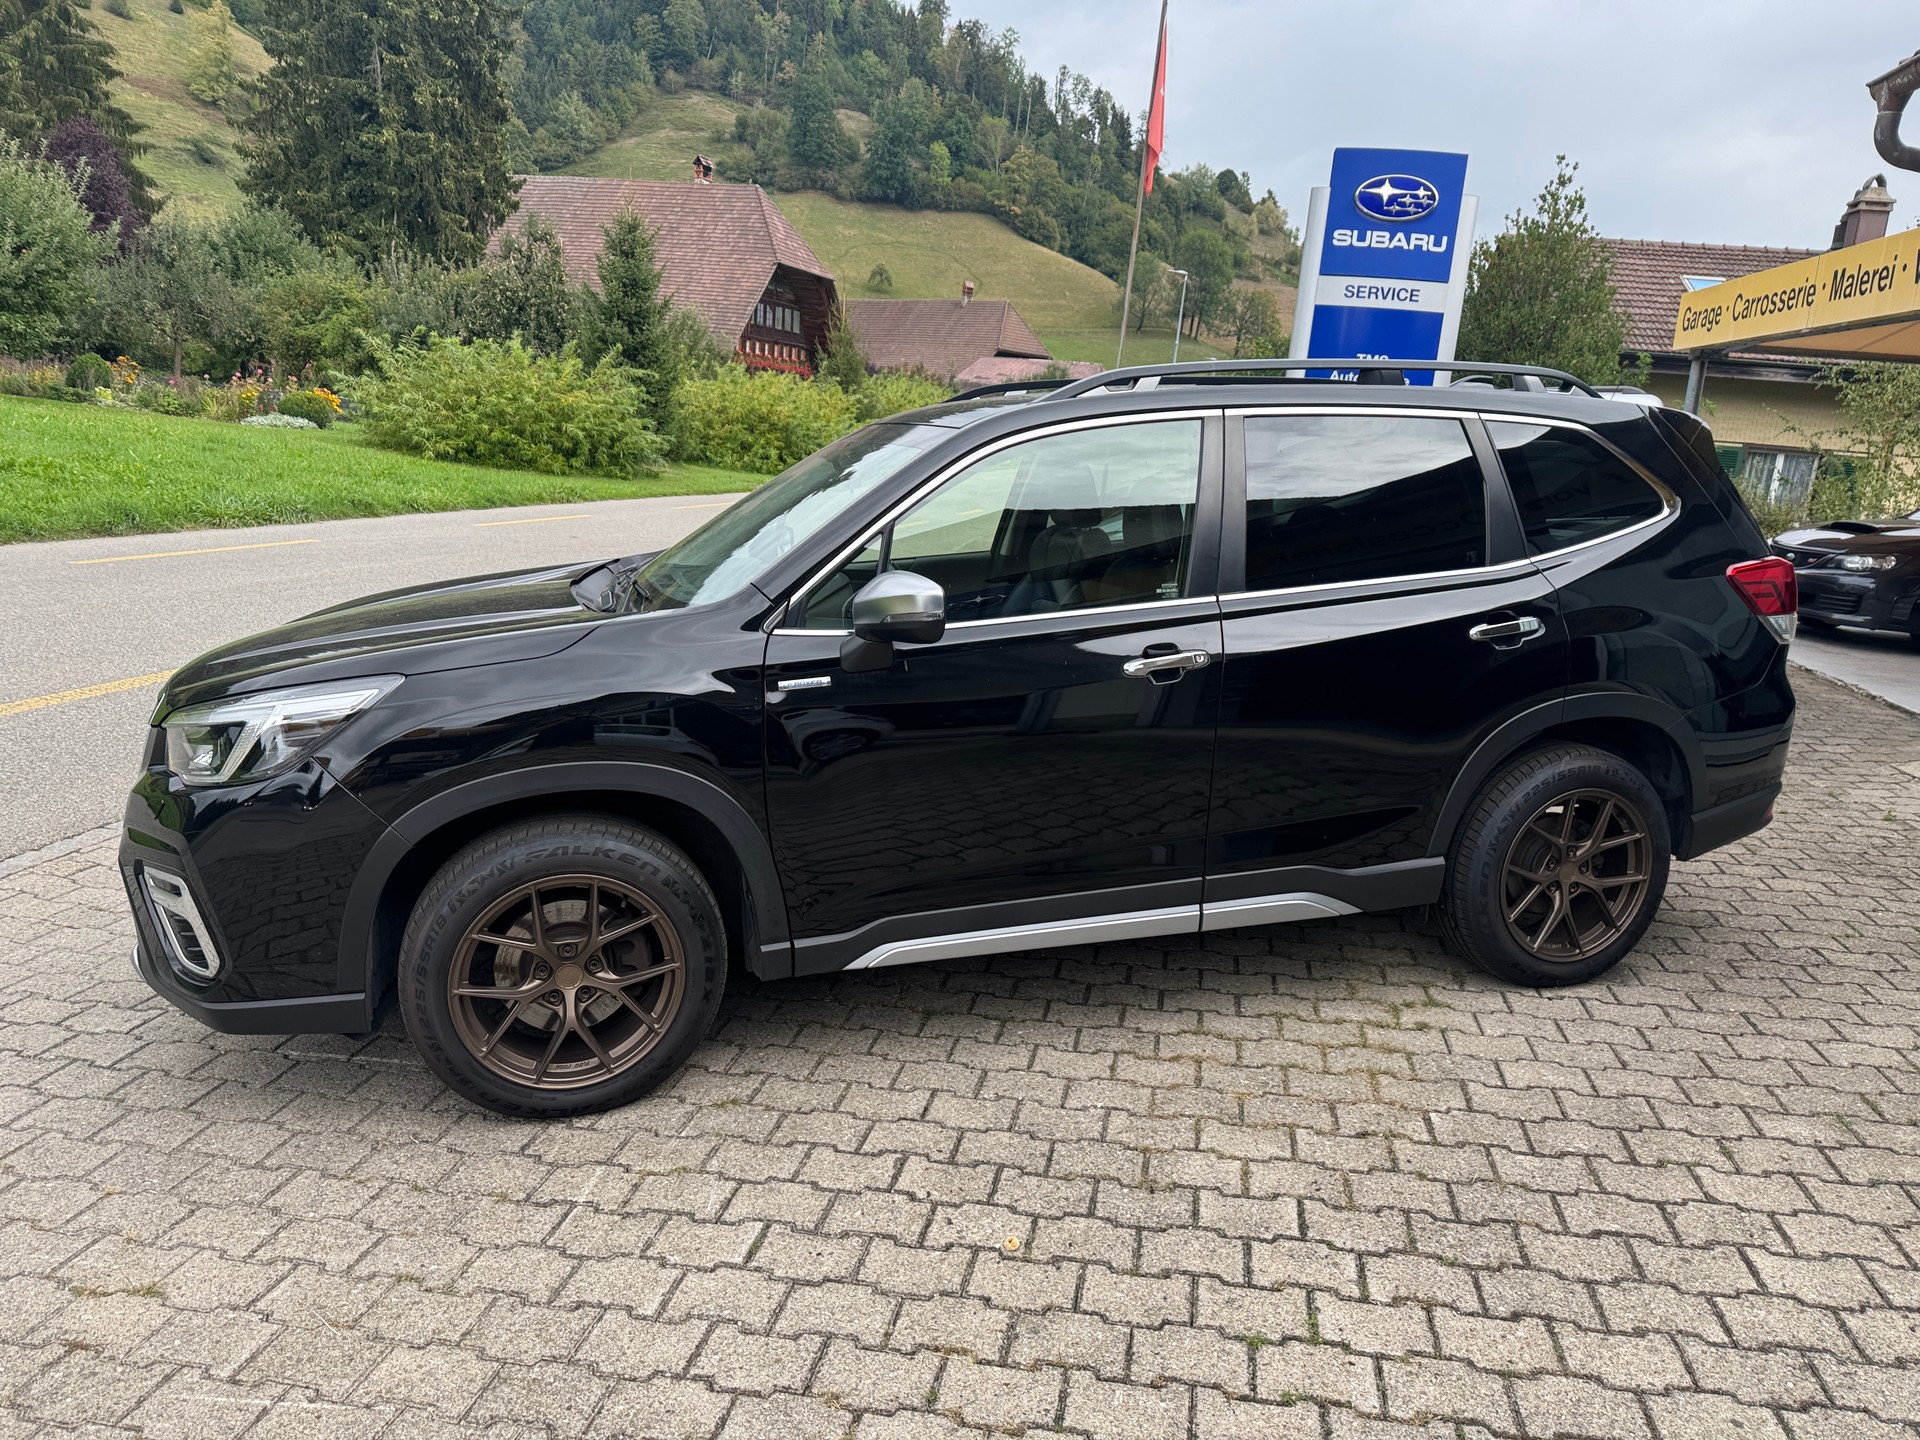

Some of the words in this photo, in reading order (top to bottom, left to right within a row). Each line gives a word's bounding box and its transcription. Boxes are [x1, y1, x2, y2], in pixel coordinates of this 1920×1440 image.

[1332, 229, 1448, 253] SUBARU
[1344, 284, 1420, 302] SERVICE
[1682, 304, 1723, 332] Garage
[1732, 277, 1817, 322] Carrosserie
[1829, 254, 1899, 302] Malerei
